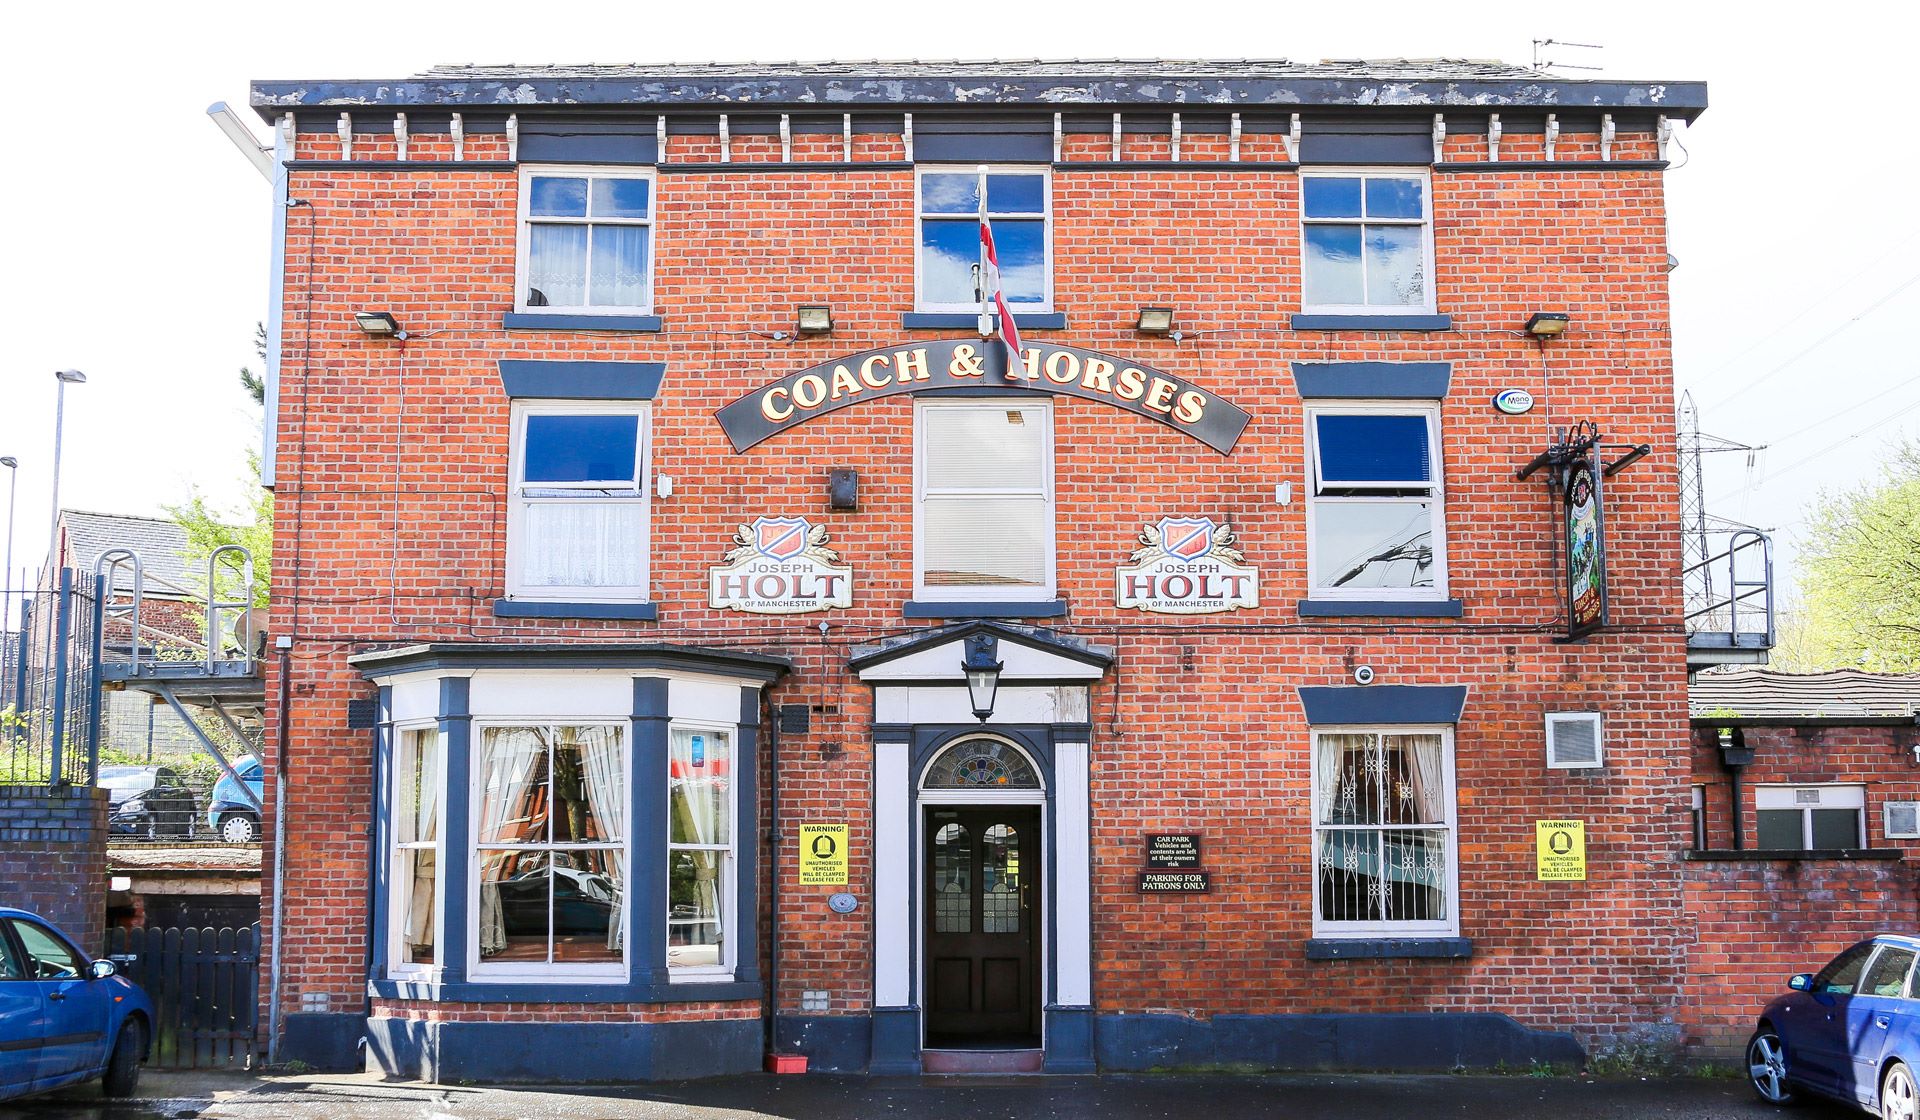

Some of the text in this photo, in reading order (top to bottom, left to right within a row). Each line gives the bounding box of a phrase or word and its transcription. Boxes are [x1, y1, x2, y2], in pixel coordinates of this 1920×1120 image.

[761, 348, 931, 423] COACH
[949, 343, 985, 379] &
[748, 562, 814, 574] JOSEPH
[1155, 562, 1220, 574] JOSEPH
[718, 574, 845, 599] HOLT
[1125, 574, 1251, 599] HOLT
